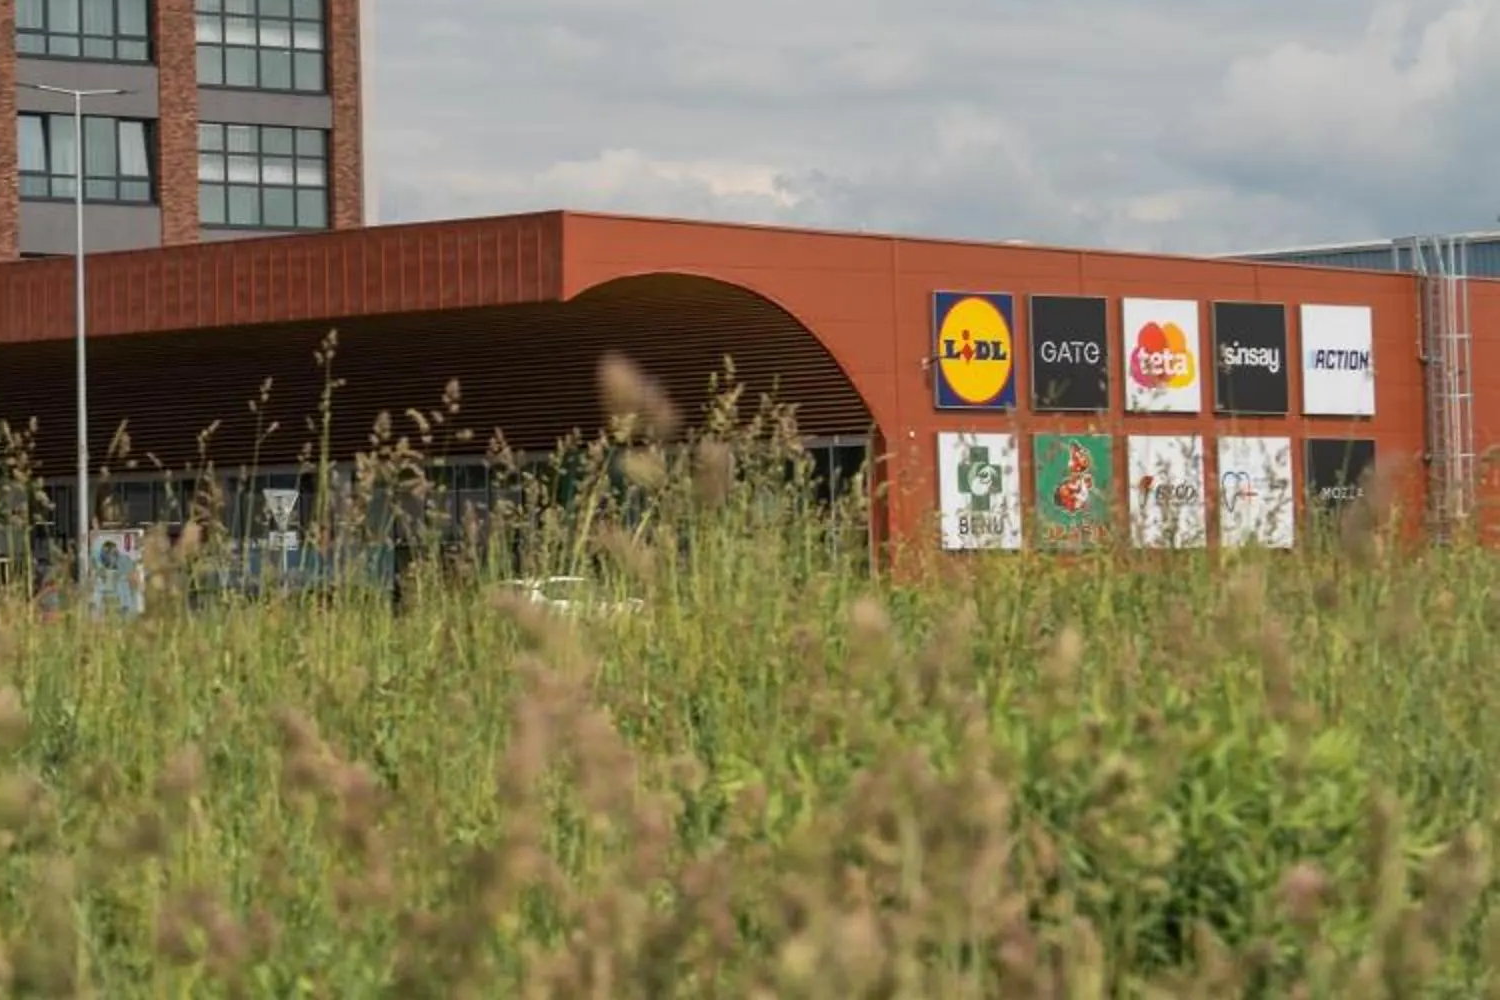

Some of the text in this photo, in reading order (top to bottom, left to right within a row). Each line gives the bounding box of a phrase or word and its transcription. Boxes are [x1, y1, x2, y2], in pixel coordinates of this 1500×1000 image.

[1137, 345, 1189, 377] teta
[1223, 340, 1280, 373] sinsay
[1314, 349, 1370, 371] ACTION
